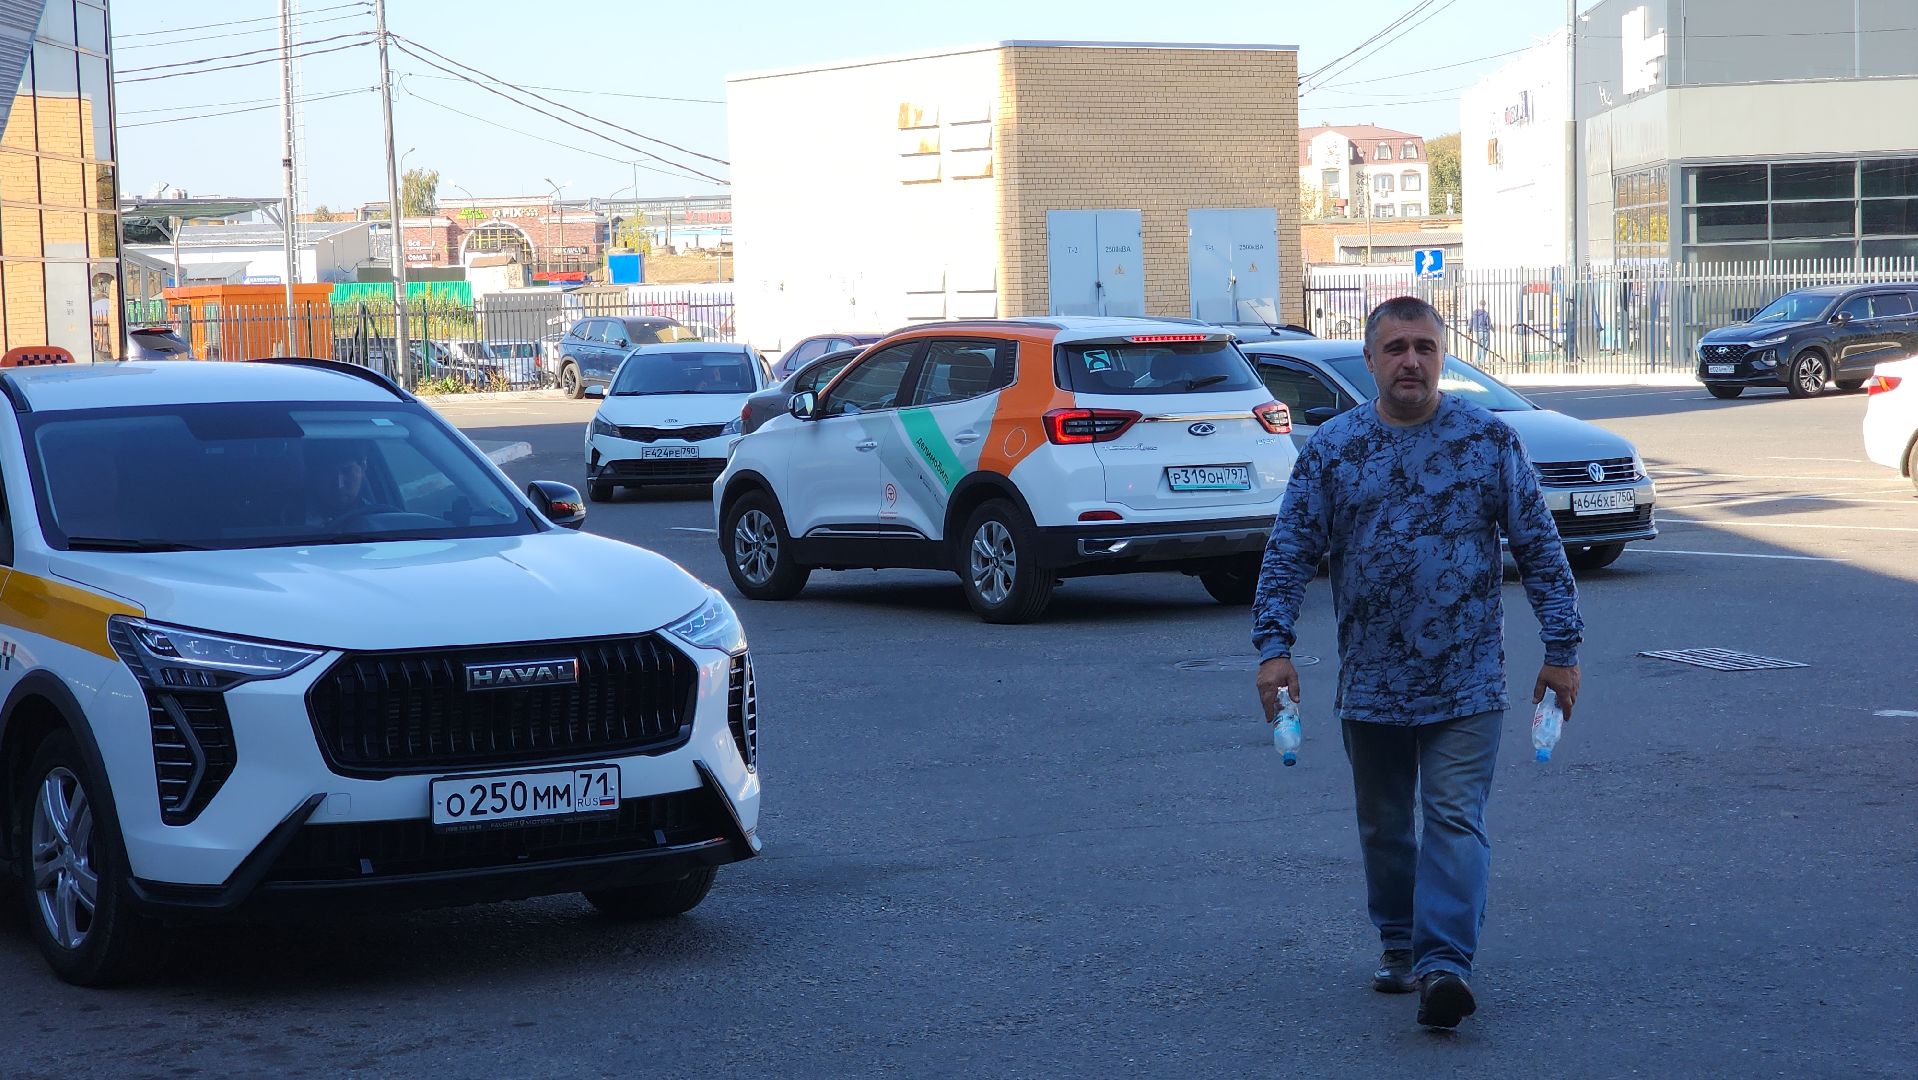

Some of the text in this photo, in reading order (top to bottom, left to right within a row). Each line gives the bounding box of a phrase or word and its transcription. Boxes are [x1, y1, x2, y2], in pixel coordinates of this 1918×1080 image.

[1173, 468, 1243, 484] Р319ОН 797
[1617, 491, 1631, 503] 750
[473, 665, 574, 685] HAVAL
[446, 772, 608, 817] О250ММ 71
[577, 797, 599, 808] RUS
